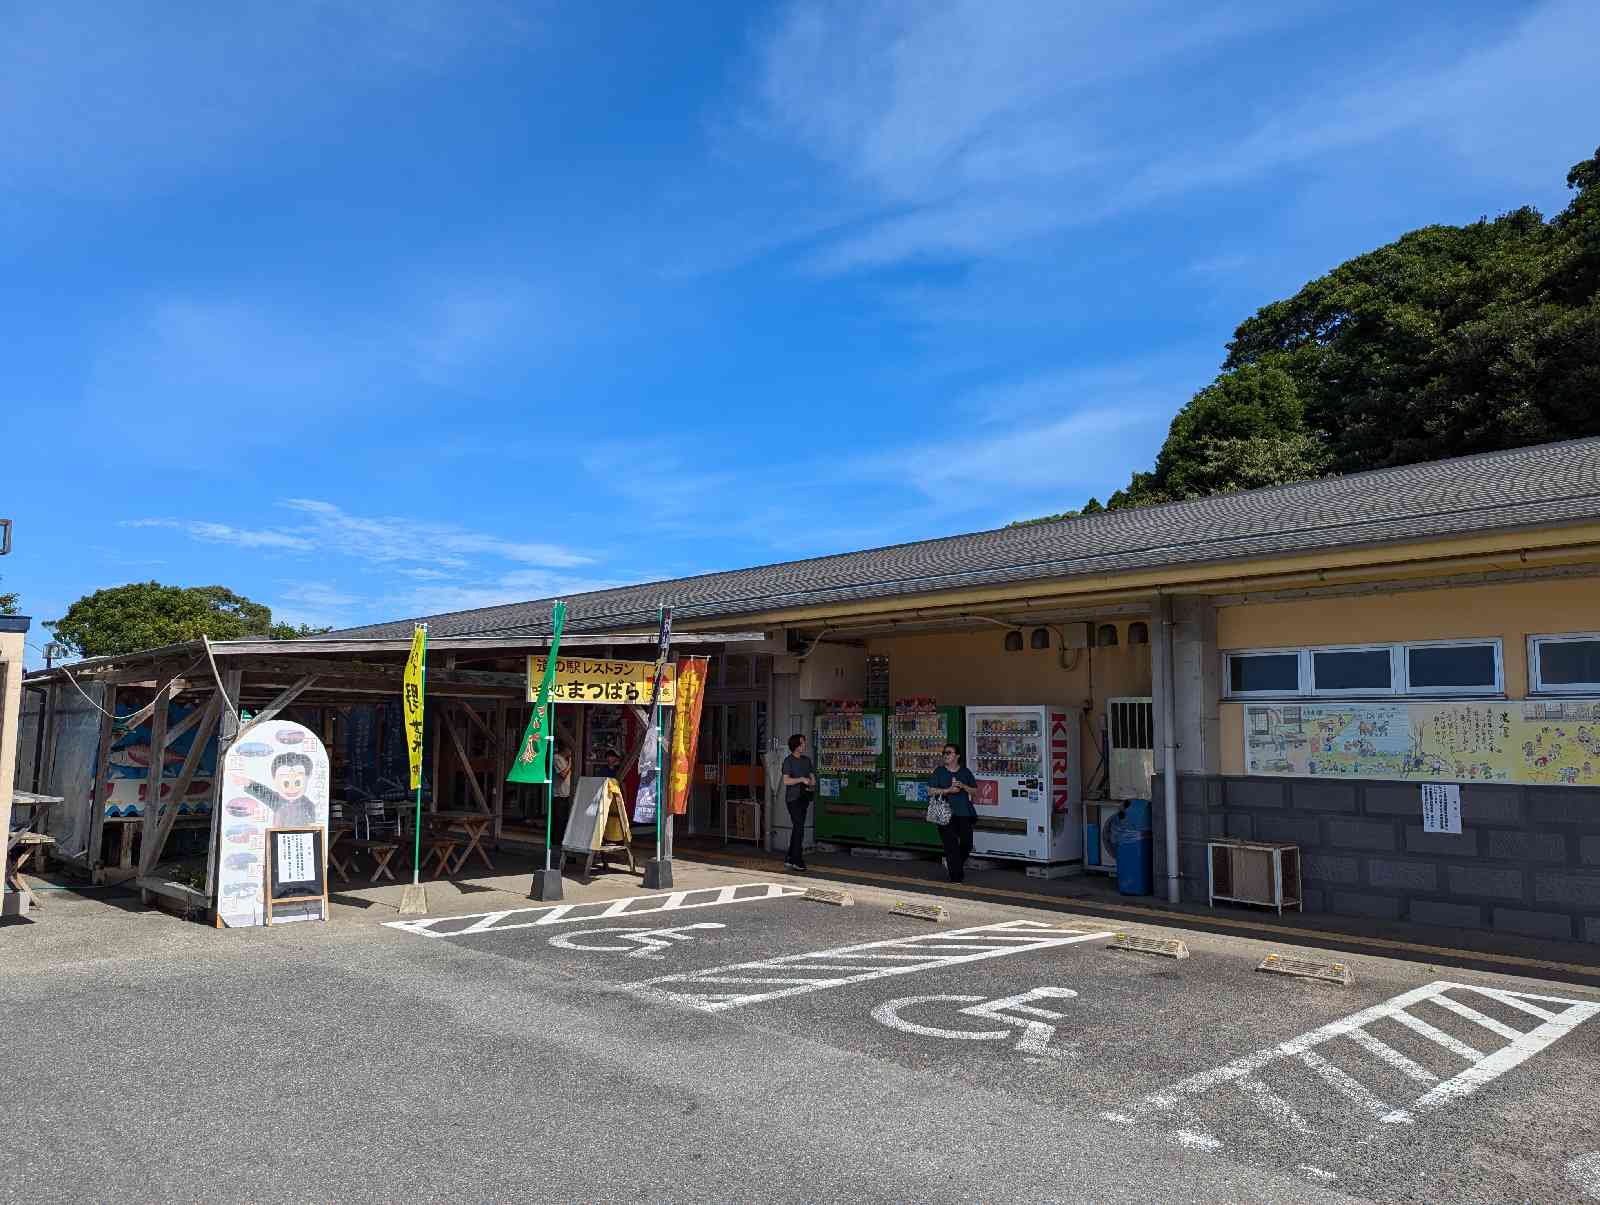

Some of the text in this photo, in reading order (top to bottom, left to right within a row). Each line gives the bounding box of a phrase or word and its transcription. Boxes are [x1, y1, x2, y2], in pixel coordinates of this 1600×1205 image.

[567, 679, 640, 701] まつばら
[1051, 712, 1069, 816] KIRIN
